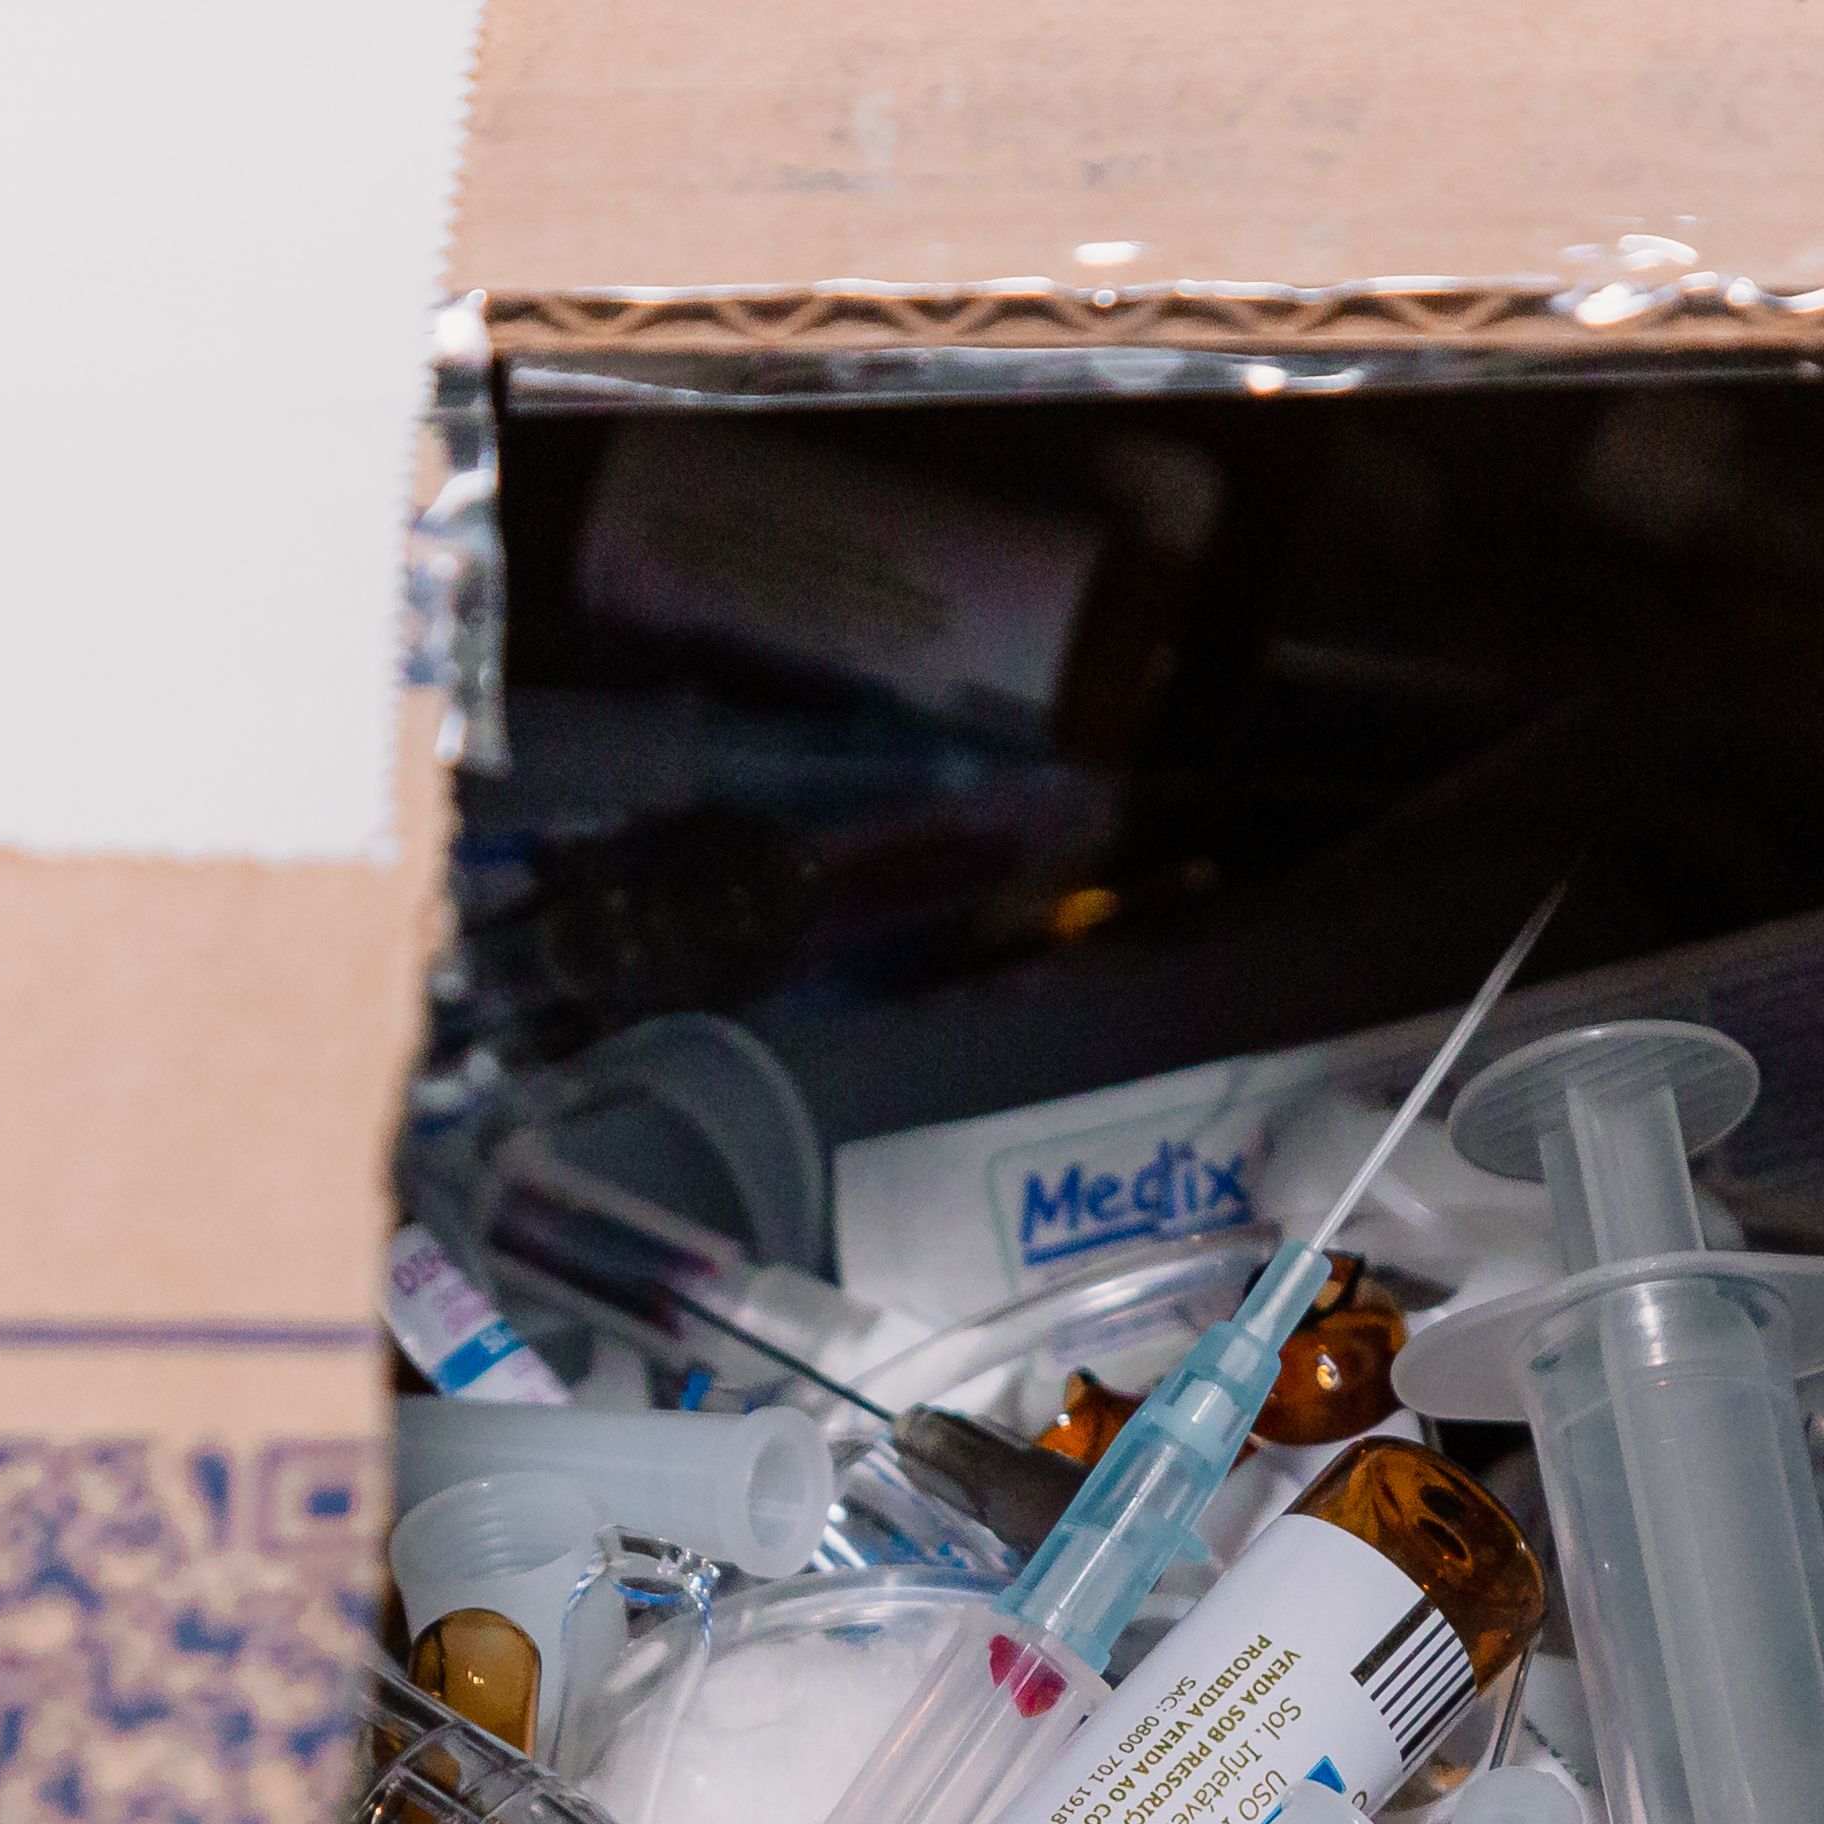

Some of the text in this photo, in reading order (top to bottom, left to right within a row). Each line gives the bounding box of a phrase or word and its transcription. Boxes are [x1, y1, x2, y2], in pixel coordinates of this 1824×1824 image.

[1019, 1138, 1253, 1243] Medix
[1183, 1632, 1273, 1718] PROIBIDA
[1238, 1648, 1302, 1706] VENDA
[1206, 1703, 1246, 1744] SOB
[1254, 1696, 1302, 1741] Sol.
[1049, 1674, 1197, 1824] SAC: 0800 701 1918
[1129, 1719, 1194, 1775] VENDA
[1107, 1773, 1136, 1803] AO
[1237, 1768, 1288, 1821] USO
